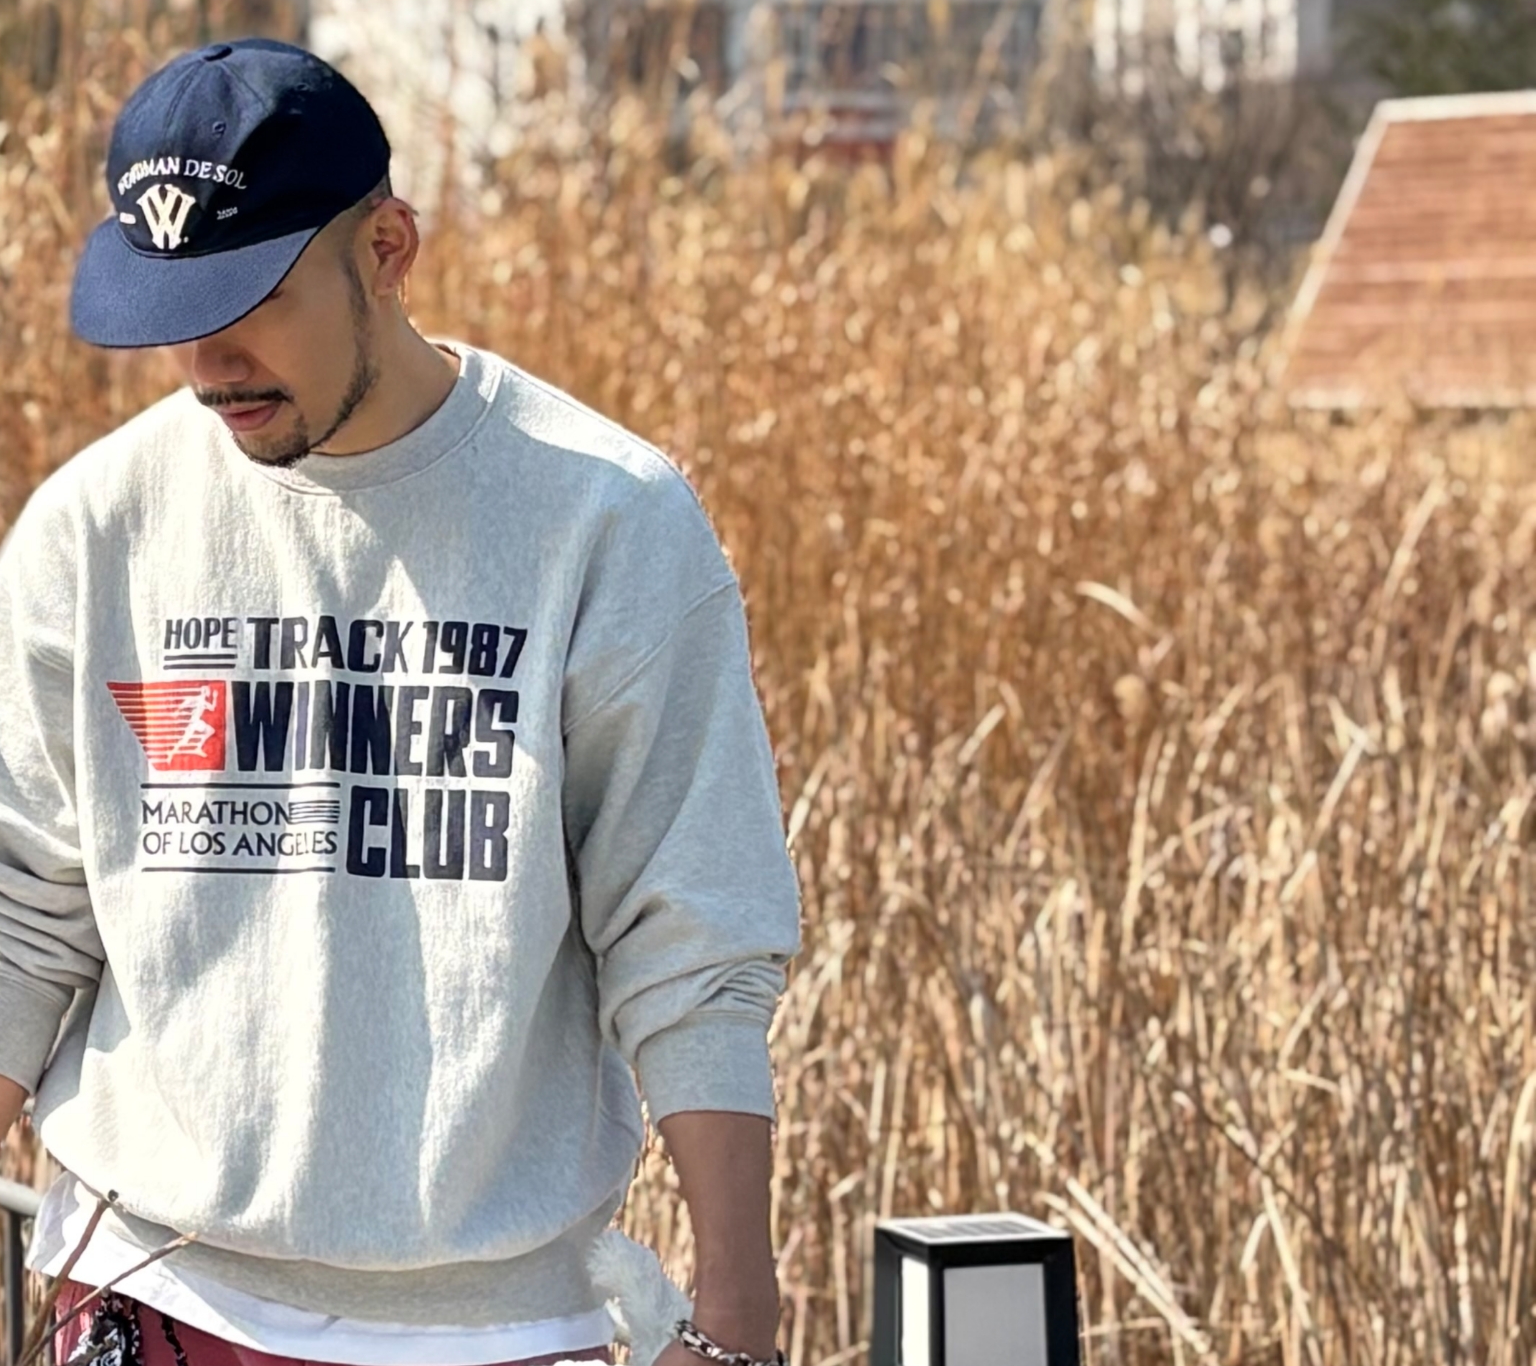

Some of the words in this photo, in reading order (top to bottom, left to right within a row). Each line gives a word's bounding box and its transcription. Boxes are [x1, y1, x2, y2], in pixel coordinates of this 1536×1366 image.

[183, 159, 213, 179] DE
[212, 164, 247, 190] SOL
[164, 617, 238, 650] HOPE
[246, 615, 414, 673] TRACK
[422, 620, 529, 678] 1987
[232, 679, 519, 779] WINNERS
[141, 799, 292, 825] MARATHON
[346, 784, 511, 882] CLUB
[142, 831, 173, 855] OF
[178, 830, 227, 856] LOS
[231, 829, 339, 857] ANGELES
